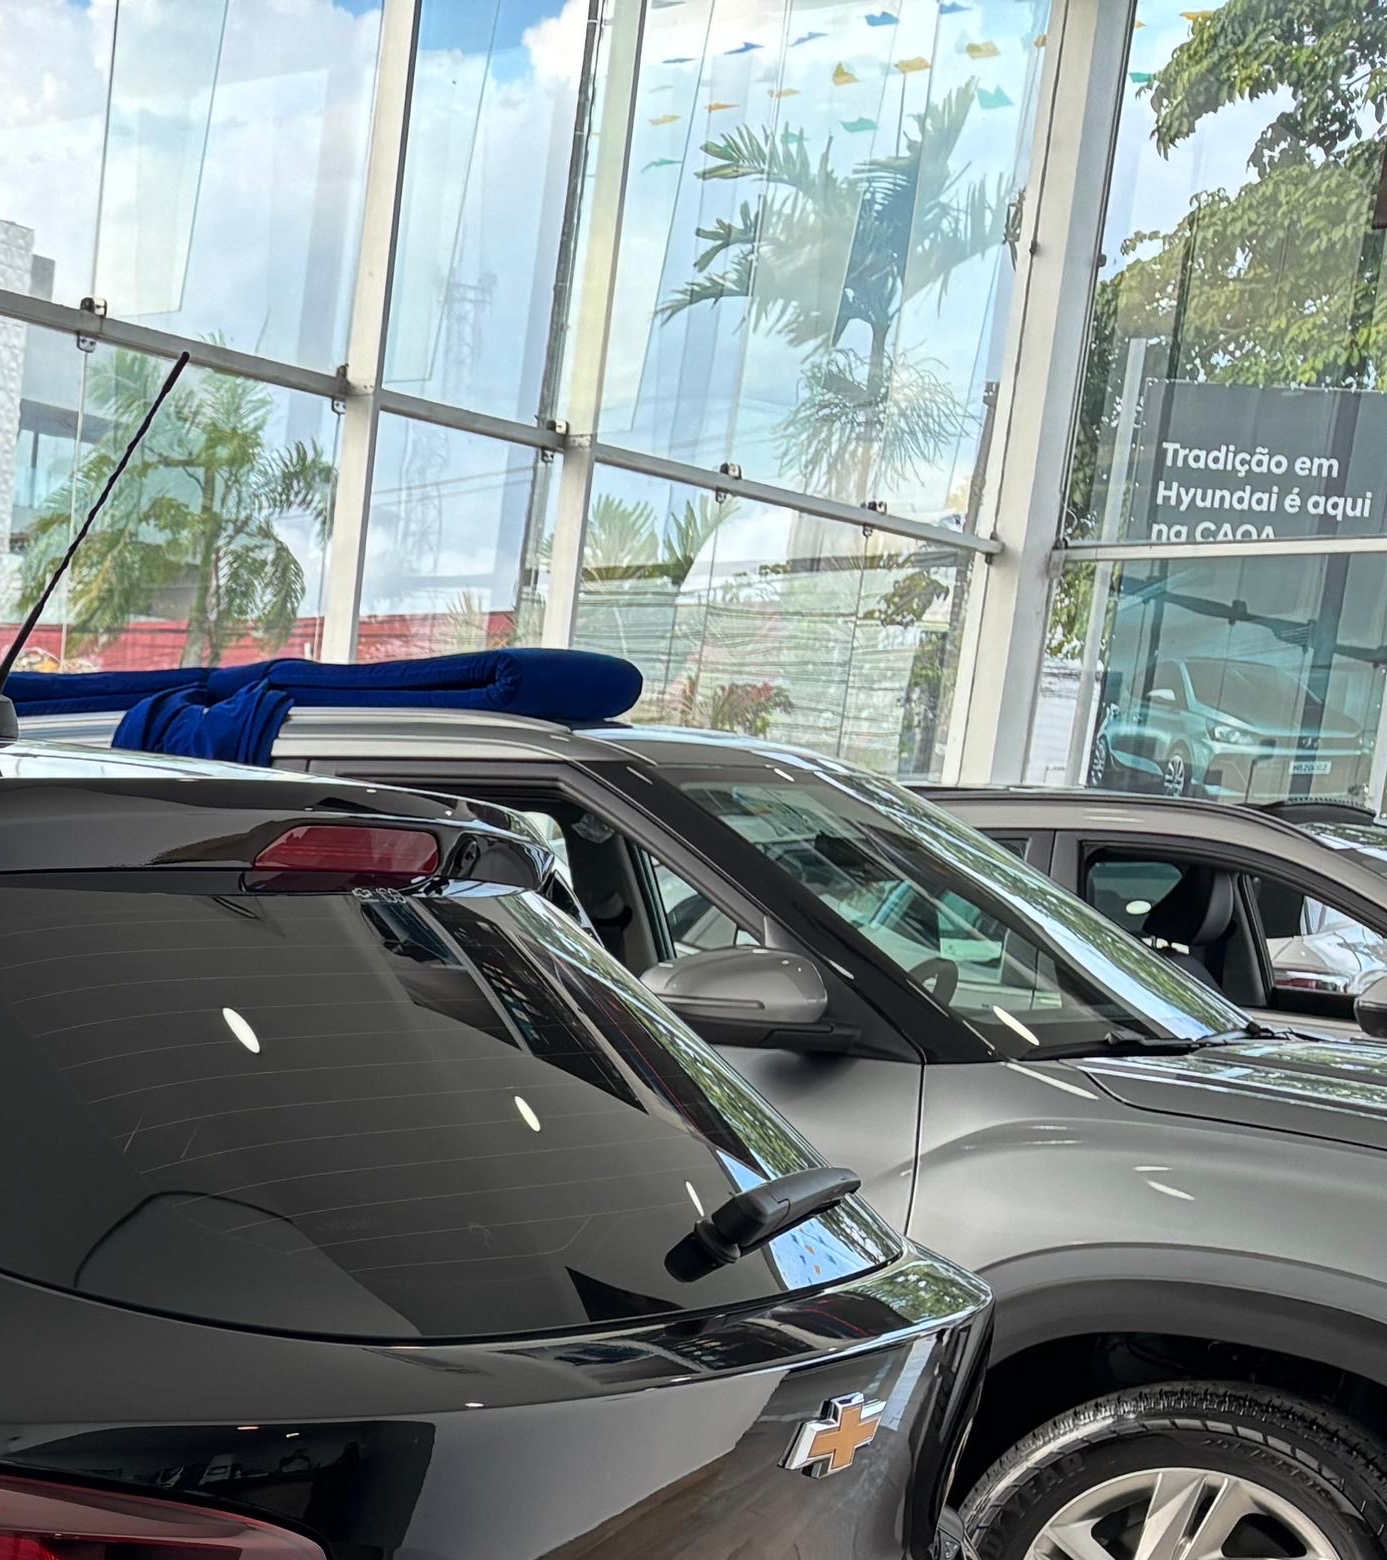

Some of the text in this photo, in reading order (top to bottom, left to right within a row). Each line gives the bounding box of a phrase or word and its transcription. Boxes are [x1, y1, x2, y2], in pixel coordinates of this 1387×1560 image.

[1162, 442, 1339, 478] Tradição em
[1156, 480, 1373, 521] Hyundai é aqui
